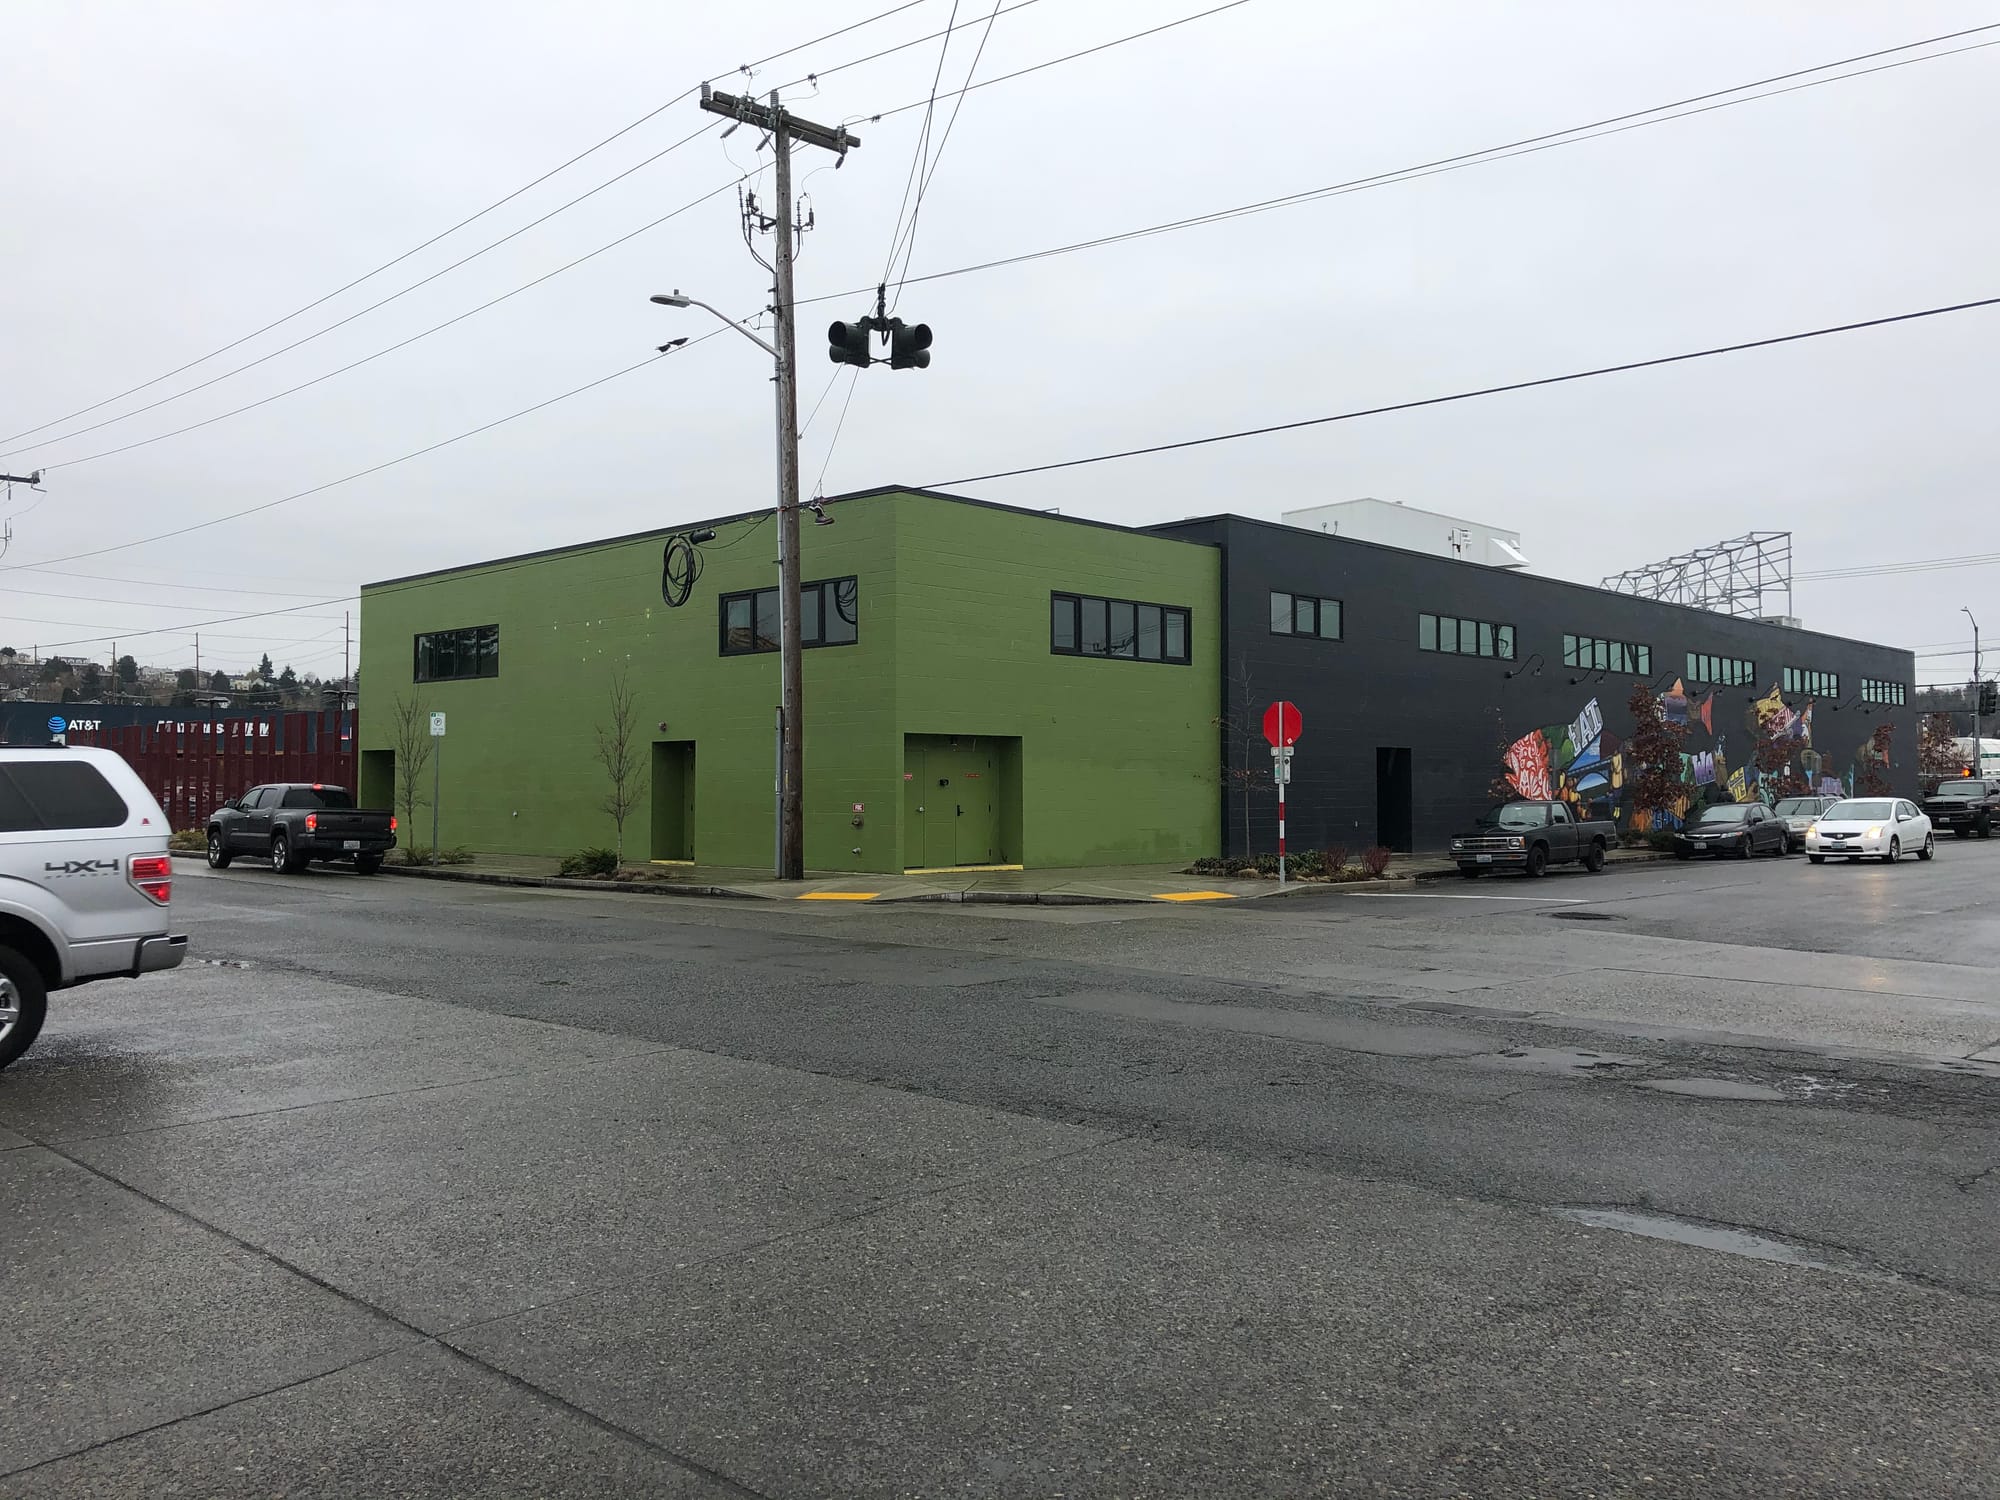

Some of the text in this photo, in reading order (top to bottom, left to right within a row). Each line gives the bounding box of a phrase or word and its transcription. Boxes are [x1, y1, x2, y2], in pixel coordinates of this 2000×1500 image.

[68, 719, 102, 731] AT&T
[1568, 696, 1604, 757] EAT
[45, 858, 120, 874] 4X4
